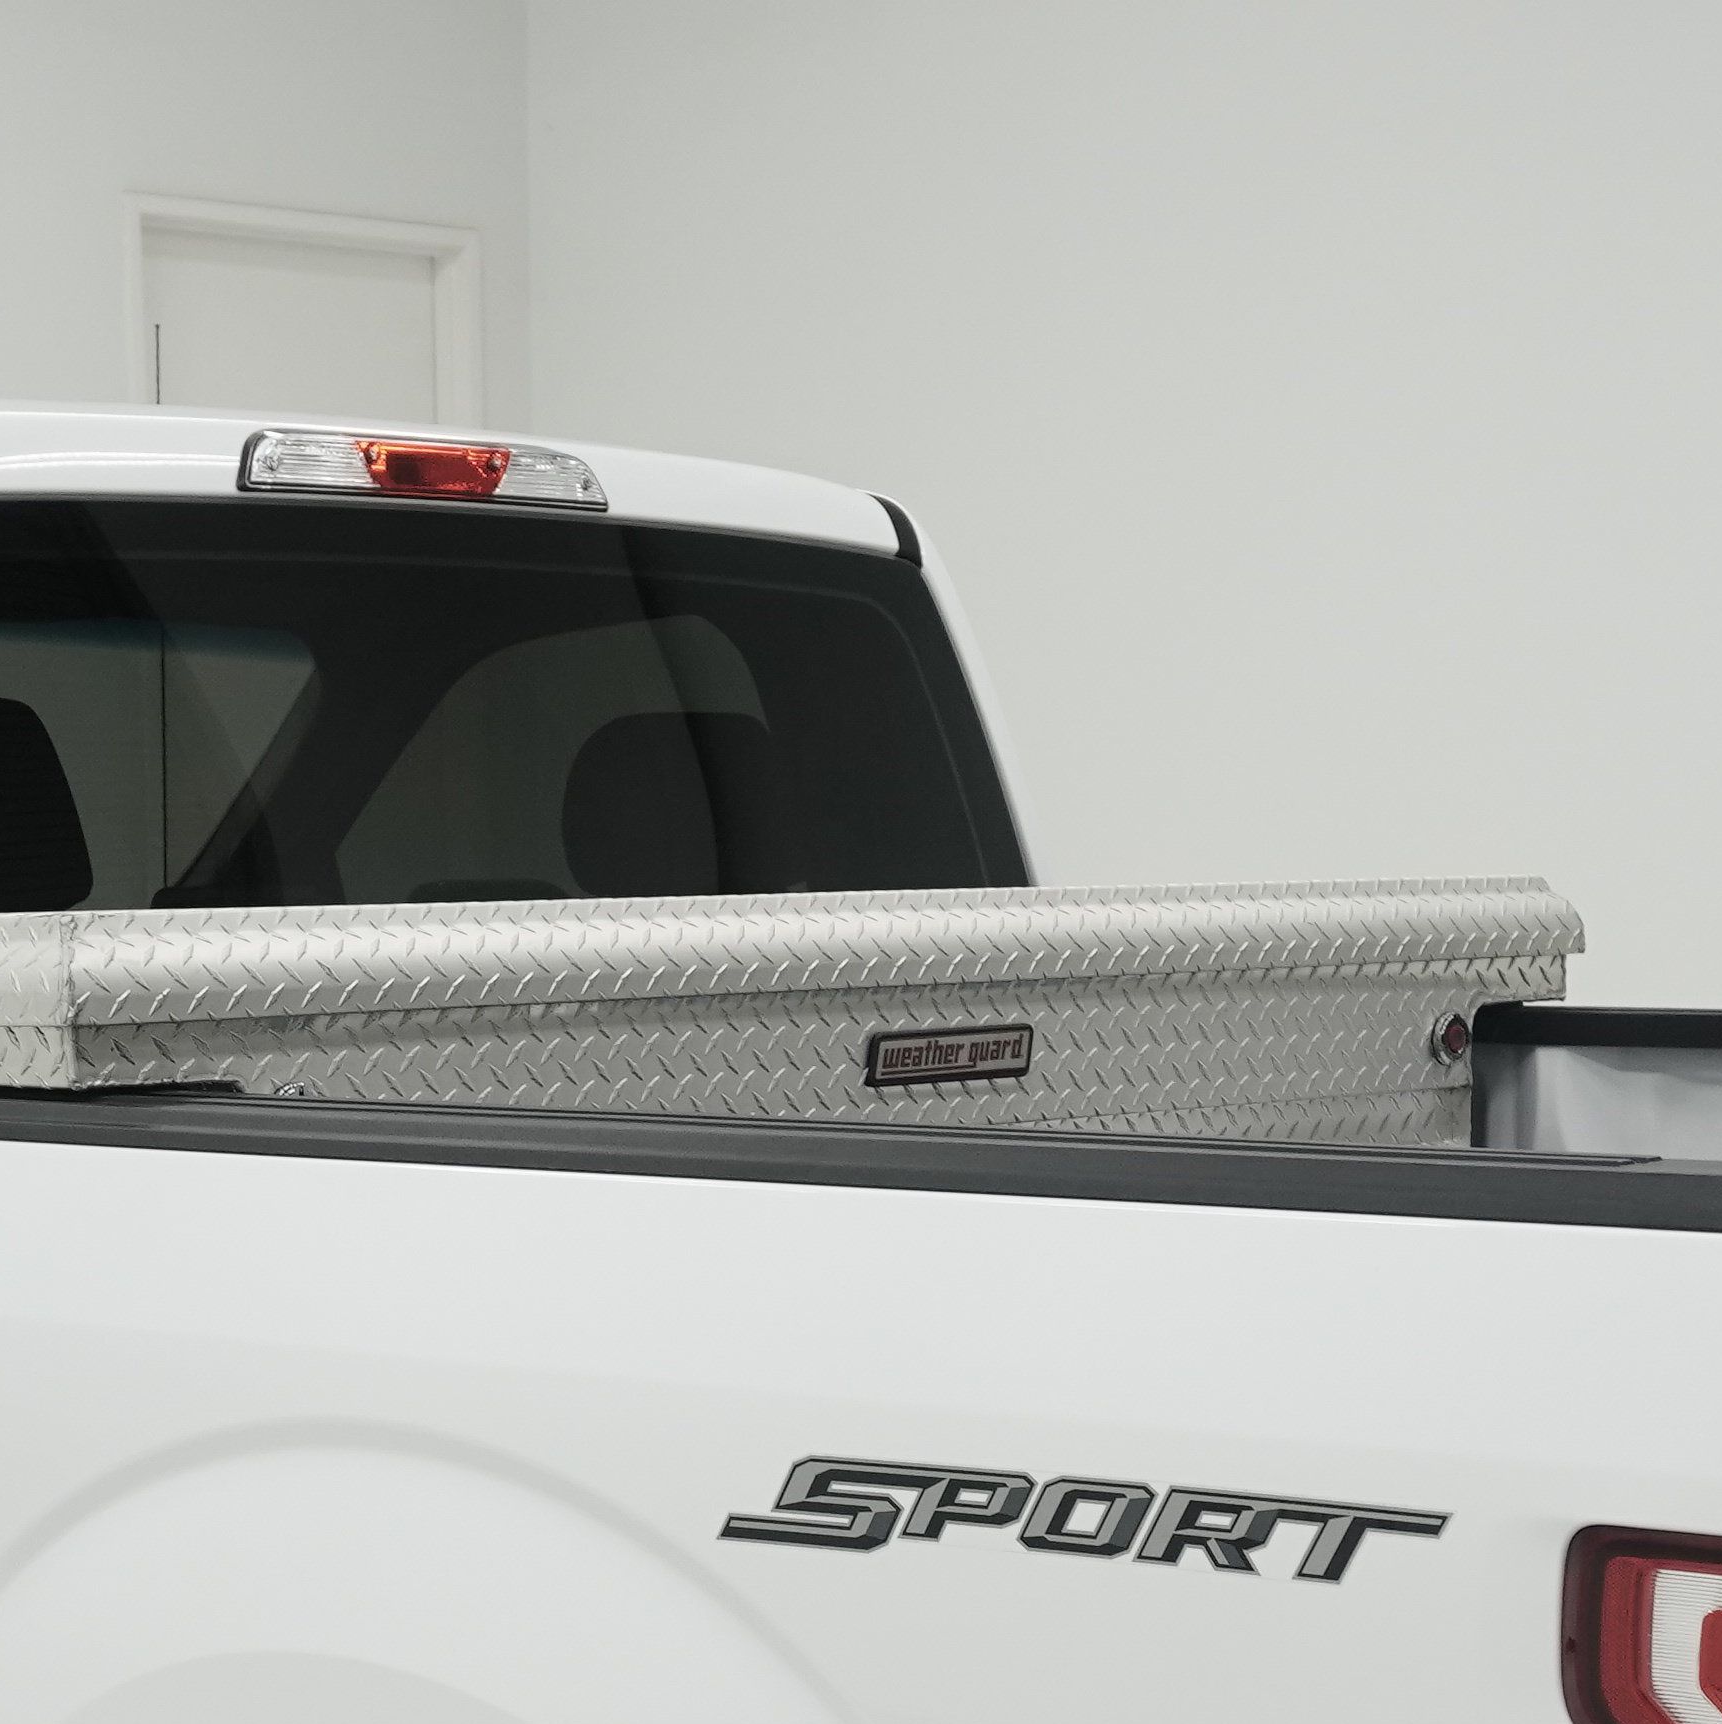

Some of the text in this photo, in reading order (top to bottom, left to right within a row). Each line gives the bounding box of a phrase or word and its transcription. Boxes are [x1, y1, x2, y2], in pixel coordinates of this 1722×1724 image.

[883, 1033, 1024, 1069] weather guard
[717, 1454, 1454, 1585] SPORT
